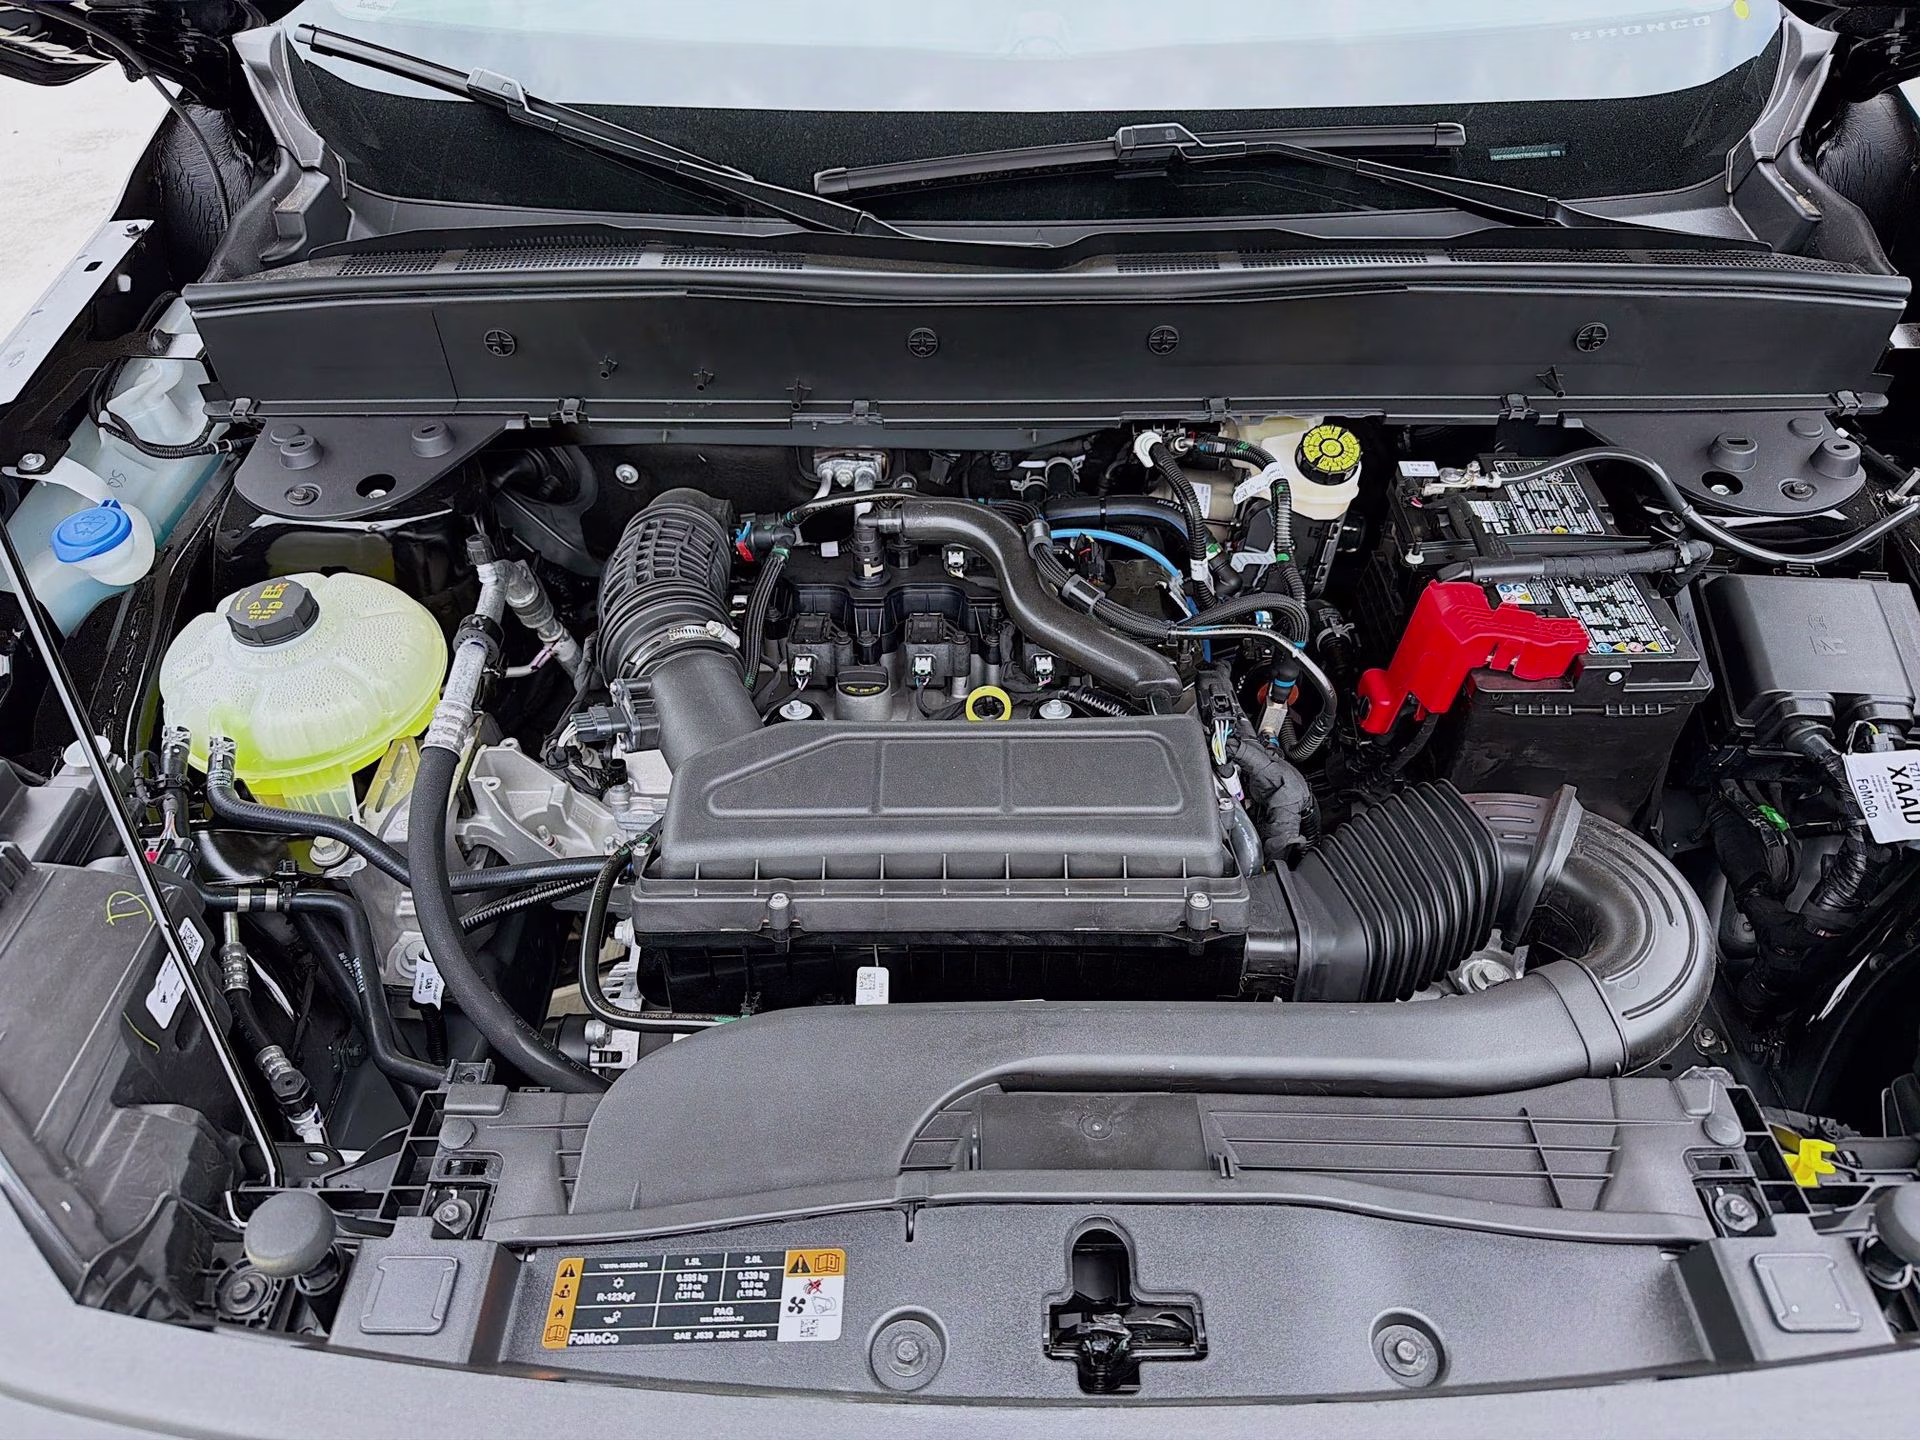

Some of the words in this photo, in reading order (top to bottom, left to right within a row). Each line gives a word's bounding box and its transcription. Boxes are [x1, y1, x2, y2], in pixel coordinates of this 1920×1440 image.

[1856, 778, 1879, 819] FoMoCo
[744, 1255, 763, 1264] 2.0L
[759, 1270, 770, 1282] kg
[596, 1291, 636, 1302] R-1234yf
[713, 1306, 734, 1316] PAG
[568, 1332, 619, 1345] FoMoCo
[673, 1332, 692, 1340] SAE
